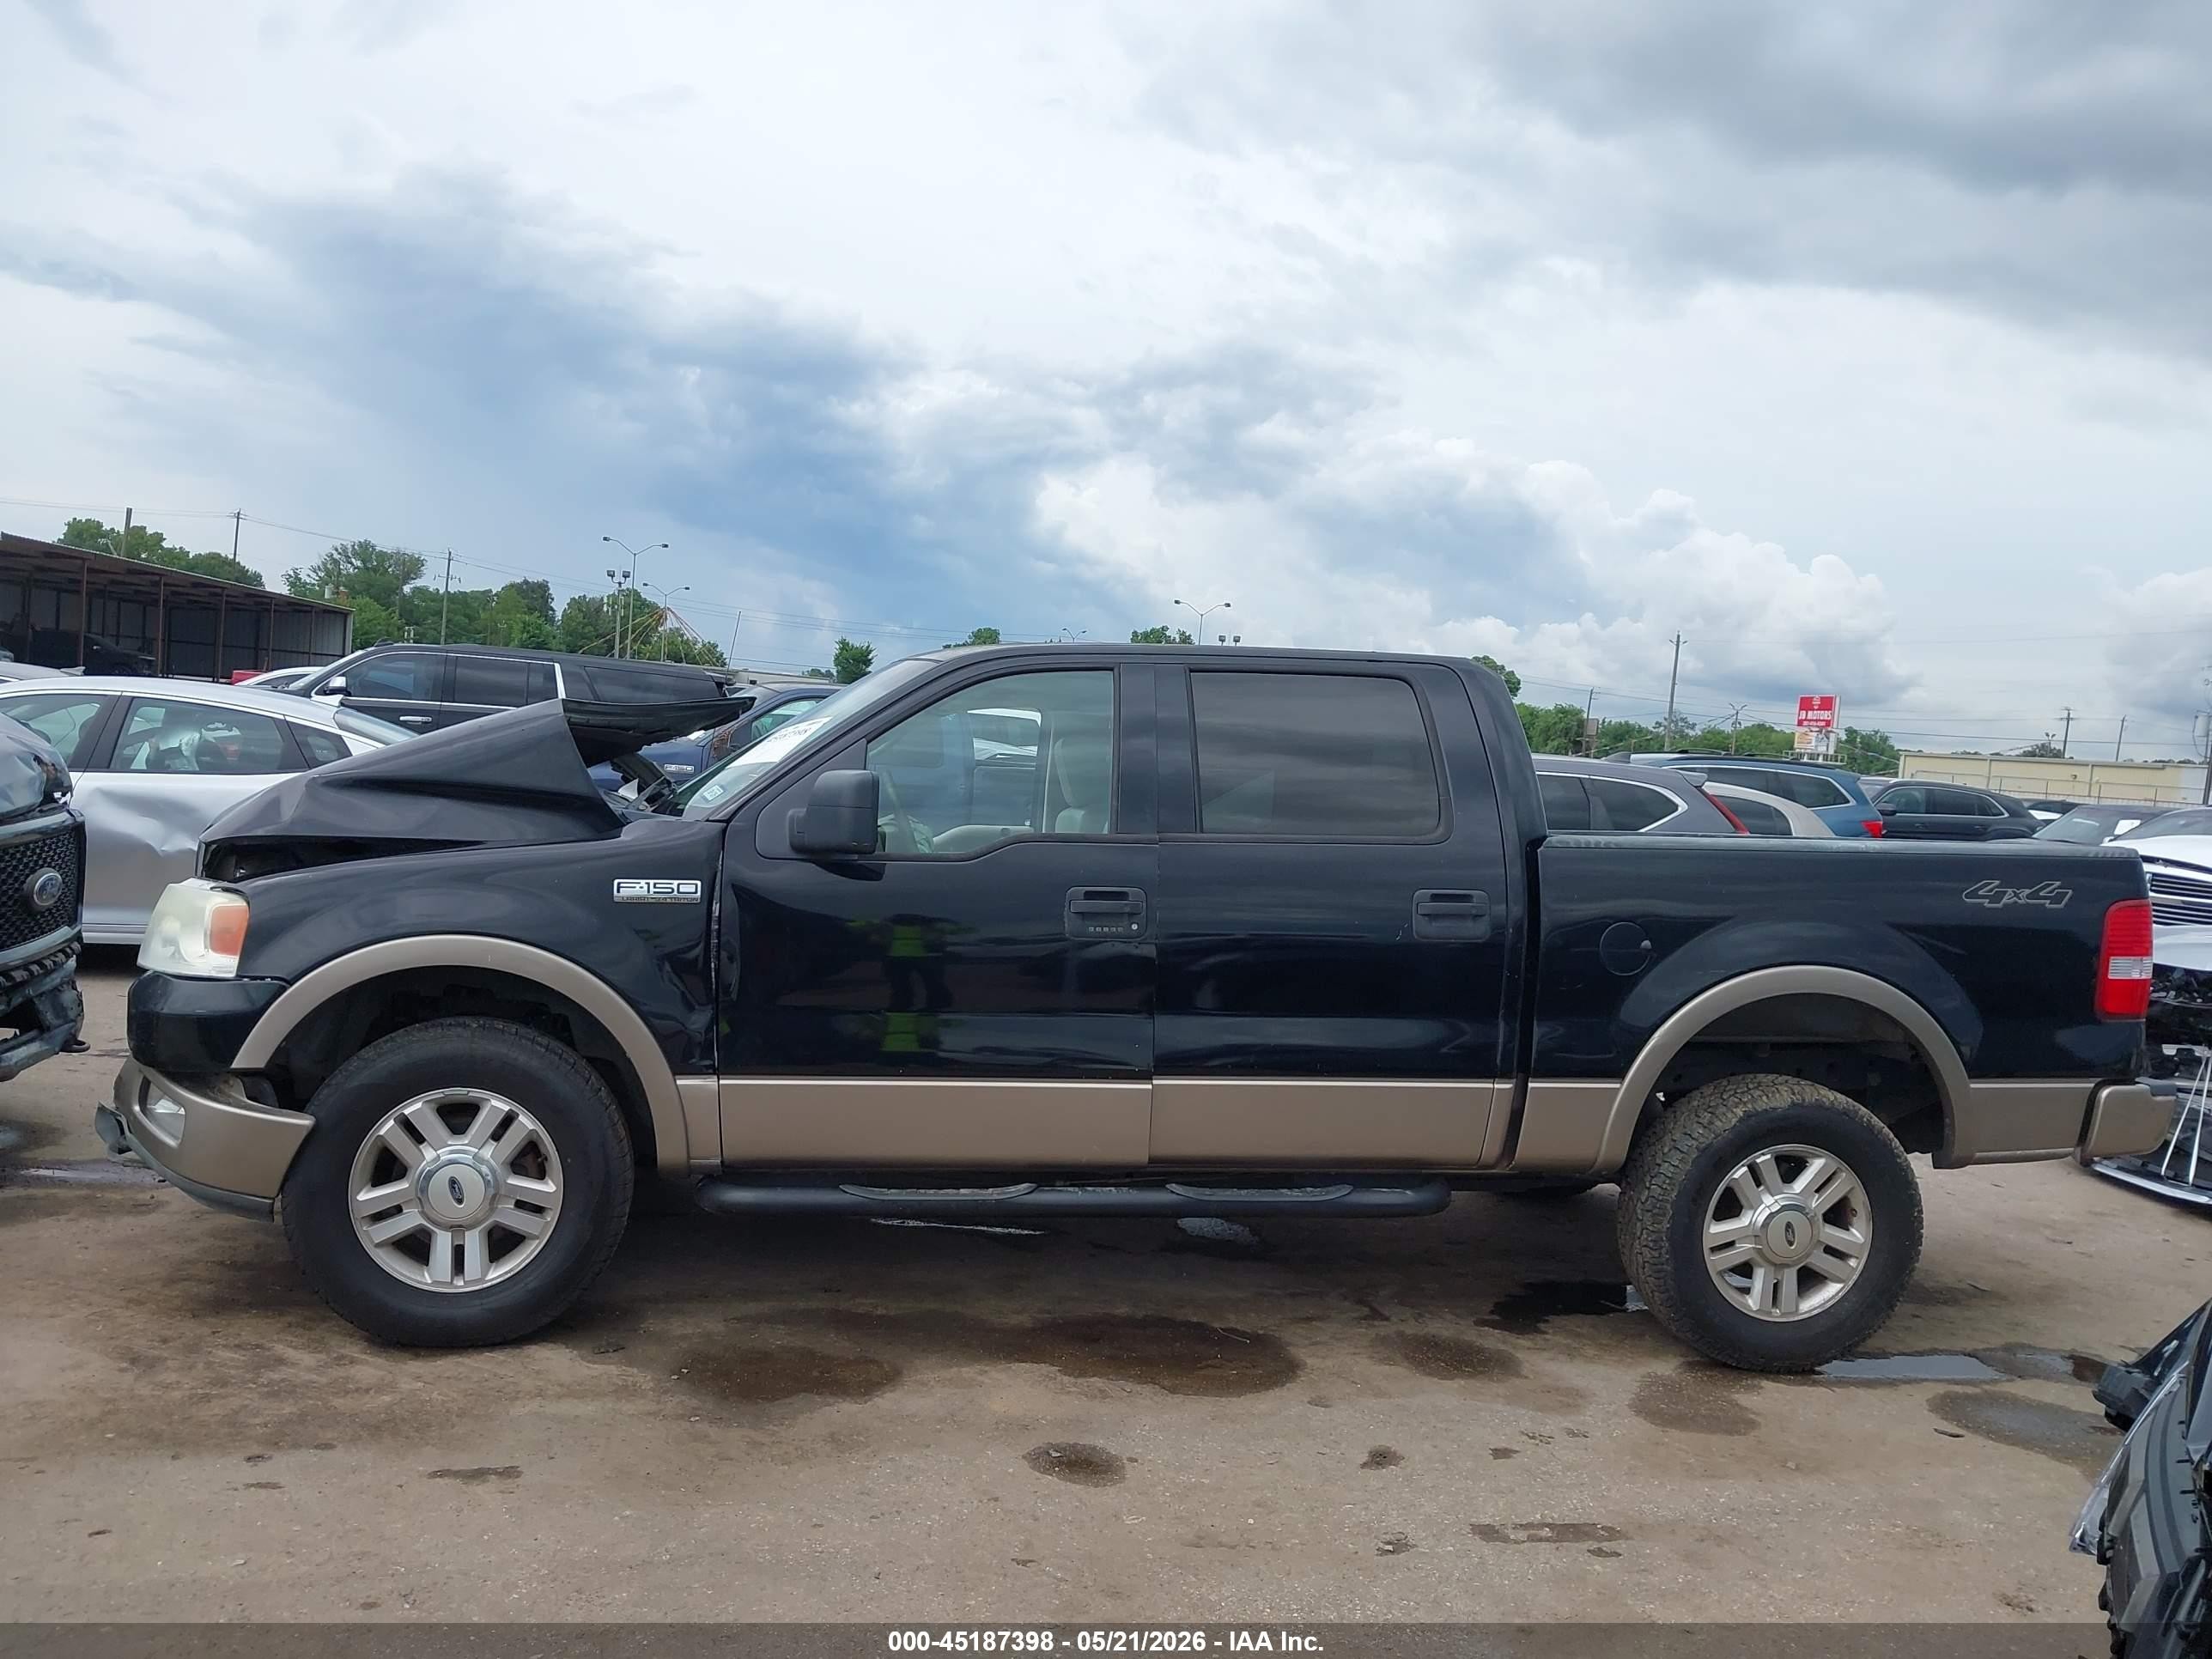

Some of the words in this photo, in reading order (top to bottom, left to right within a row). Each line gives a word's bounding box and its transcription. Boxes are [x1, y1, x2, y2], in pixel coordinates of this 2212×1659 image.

[1807, 710, 1832, 720] MOTORS
[617, 882, 698, 895] F-150
[1962, 880, 2073, 908] 4x4
